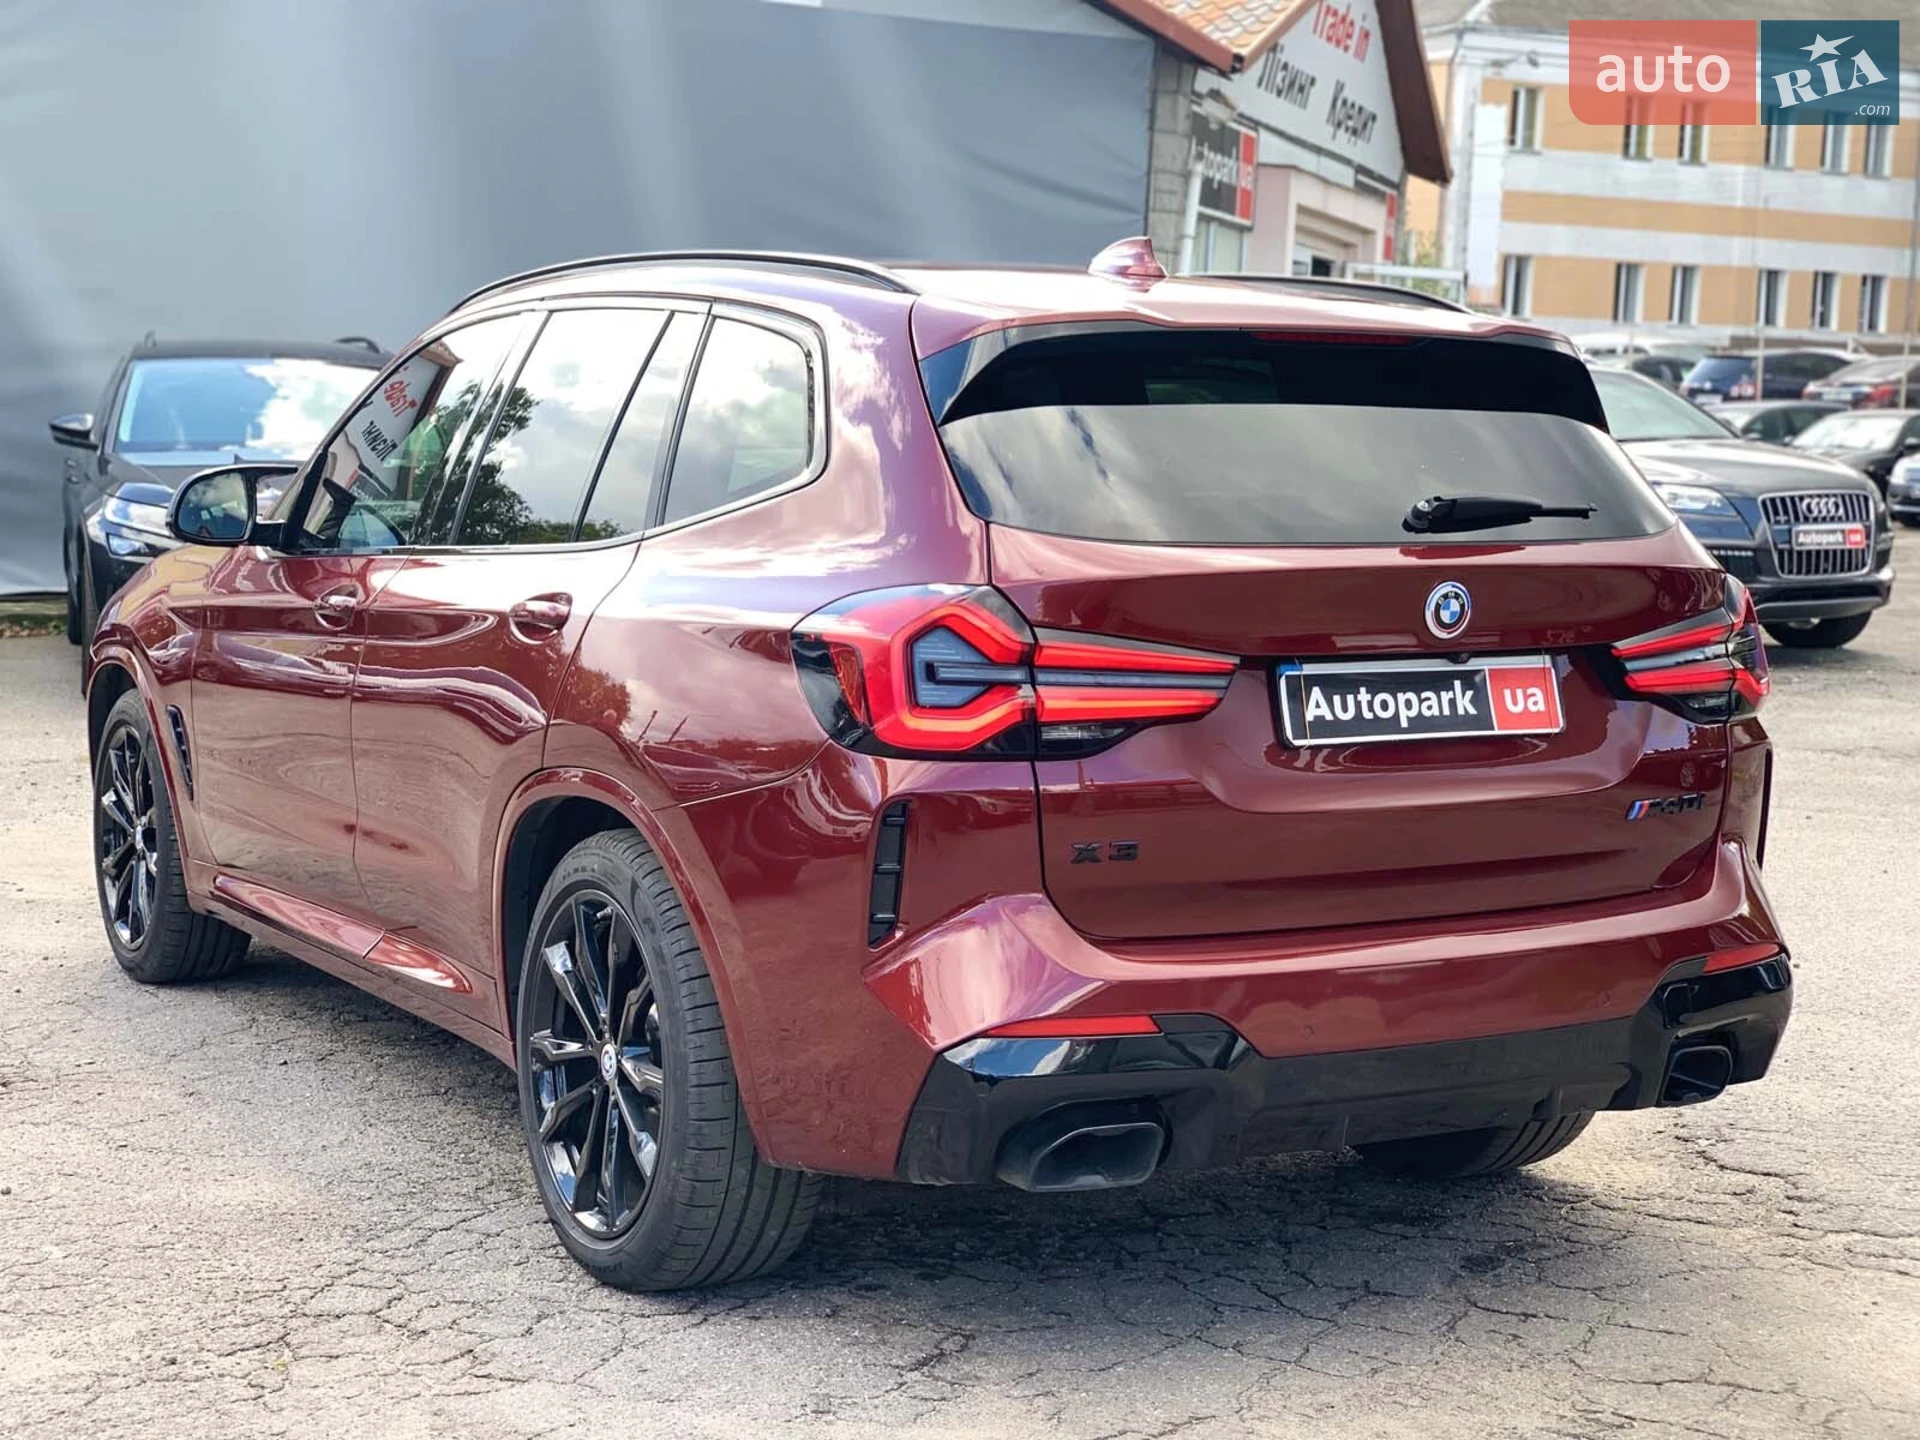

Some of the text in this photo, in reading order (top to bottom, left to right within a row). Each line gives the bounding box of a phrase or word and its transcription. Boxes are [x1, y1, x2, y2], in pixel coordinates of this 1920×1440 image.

[1312, 0, 1370, 62] Trade in
[1257, 42, 1377, 146] Лізинг Кредит
[1797, 531, 1844, 546] Autopark
[1305, 680, 1546, 728] Autopark ua
